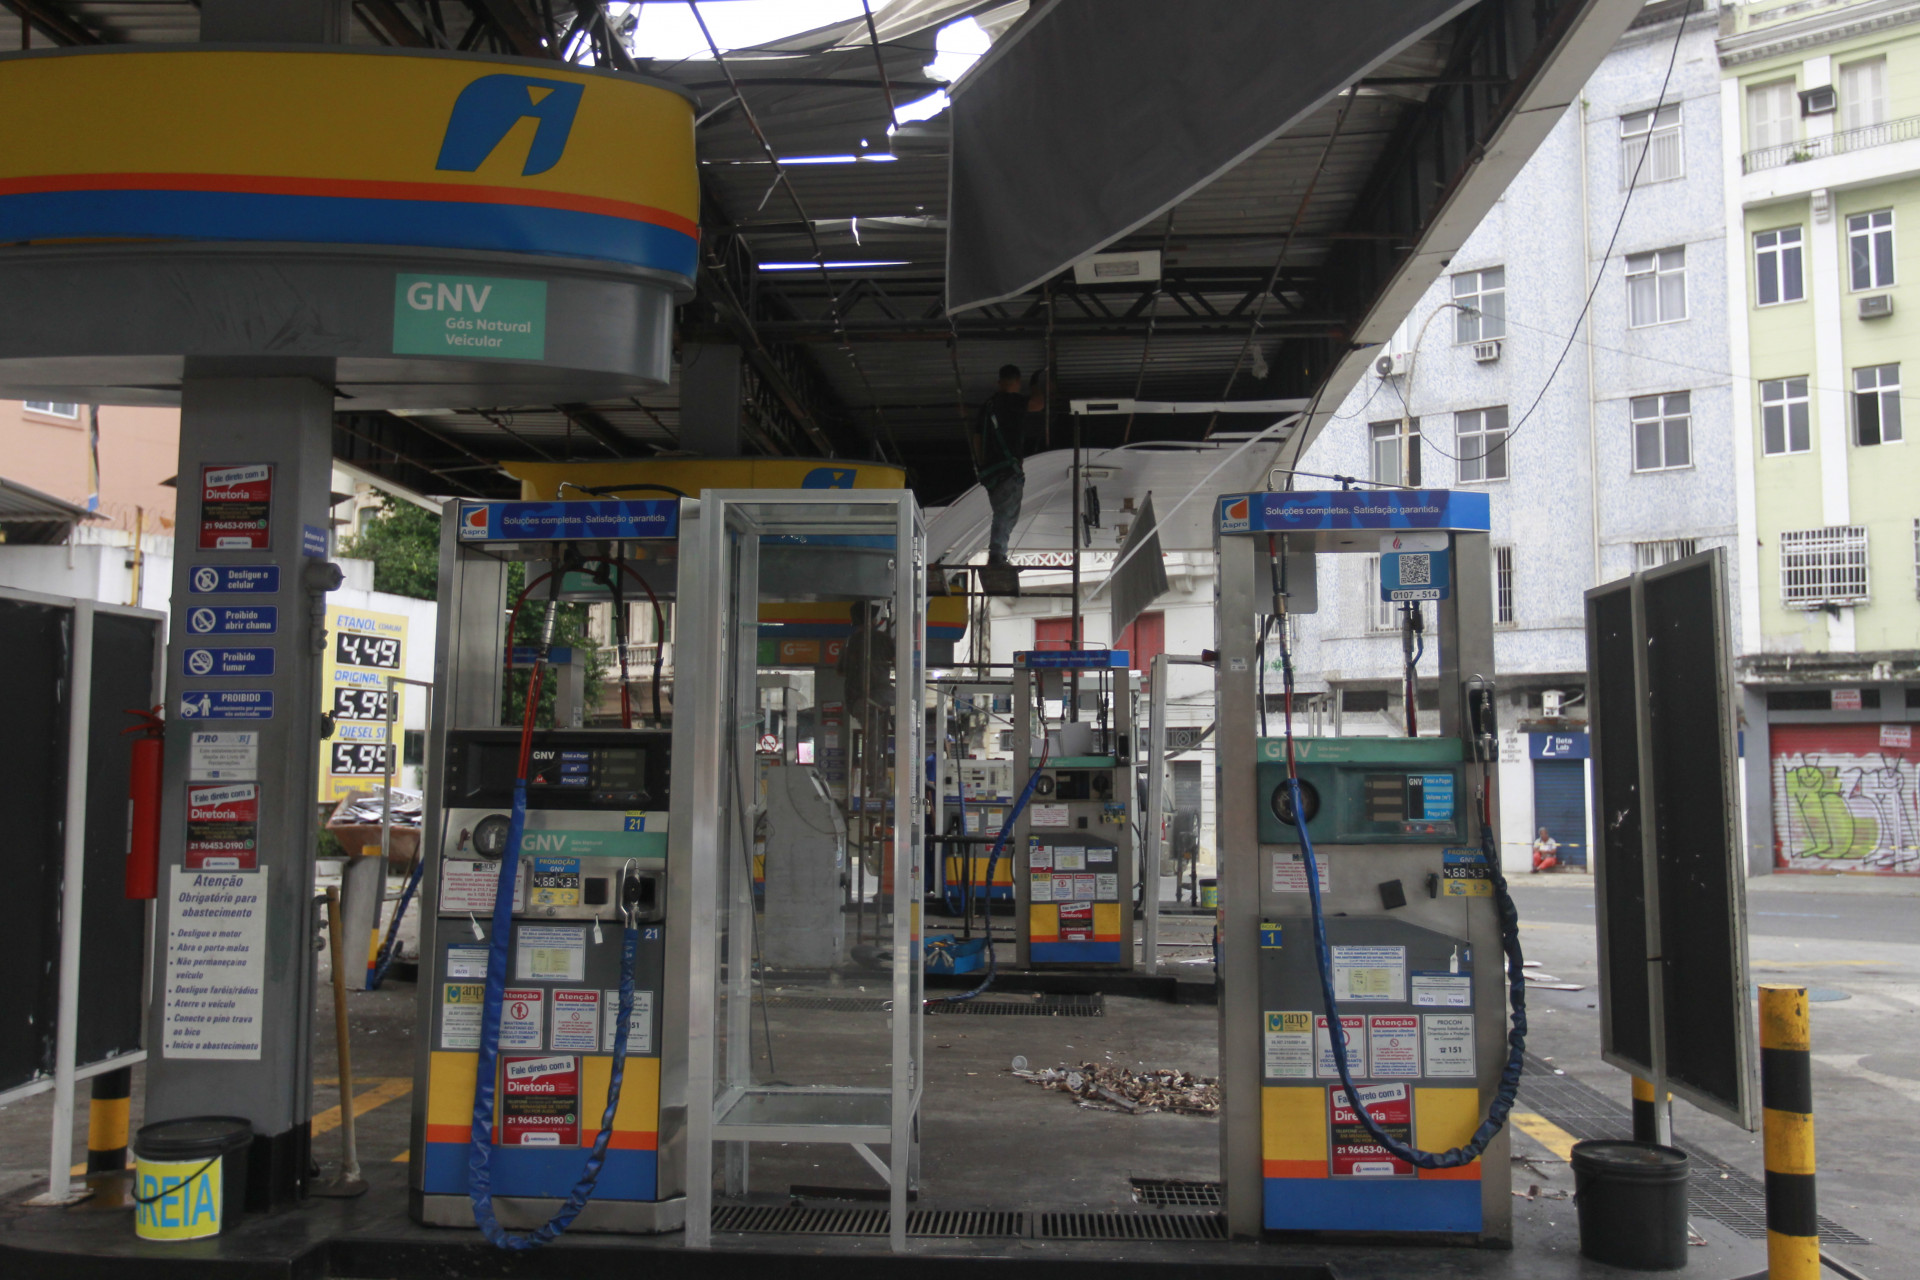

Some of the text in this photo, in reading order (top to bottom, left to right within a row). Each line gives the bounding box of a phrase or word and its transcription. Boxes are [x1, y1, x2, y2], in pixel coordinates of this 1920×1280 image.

[407, 281, 492, 313] GNV
[445, 317, 531, 333] Gás Natural
[445, 333, 503, 348] Veicular
[210, 475, 223, 483] Fale
[225, 473, 243, 481] direto
[245, 471, 259, 479] com
[206, 489, 250, 499] Diretoria
[1265, 505, 1441, 517] Soluções completas. Satisfação garantida.
[503, 514, 667, 526] Soluções completas. Satisfação garantida.
[1222, 522, 1248, 530] Aspro
[461, 528, 487, 536] Aspro
[228, 570, 261, 580] Desligue
[227, 581, 254, 589] celular
[1393, 591, 1414, 599] 0107
[1422, 590, 1437, 598] 514
[225, 611, 258, 619] Proibido
[225, 621, 272, 629] abrir chama
[337, 614, 377, 631] ETANOL
[223, 652, 256, 661] Proibido
[342, 636, 397, 666] 4,49
[223, 663, 246, 671] fumar
[334, 670, 383, 685] ORIGINAL
[222, 693, 261, 702] PROIBIDO
[339, 726, 373, 739] DIESEL
[532, 751, 555, 760] GNV
[1408, 778, 1423, 786] GNV
[194, 793, 209, 803] Fale
[210, 791, 230, 800] direto
[231, 790, 245, 798] com
[191, 809, 236, 819] Diretoria
[629, 818, 641, 830] 21
[200, 842, 243, 850] 96453-0190
[521, 834, 567, 851] GNV
[539, 858, 576, 867] PROMOÇÃO
[1444, 868, 1466, 878] 4,68
[193, 874, 244, 890] Atenção
[535, 876, 579, 888] 4,68 4,37
[178, 892, 257, 905] Obrigatório para
[181, 906, 252, 918] abastecimento
[177, 928, 211, 939] Desligue
[219, 930, 242, 938] motor
[645, 928, 658, 939] 21
[1268, 932, 1274, 945] 1
[177, 944, 196, 952] Abra
[203, 944, 249, 953] porta-malas
[1463, 949, 1470, 961] 1
[176, 957, 192, 966] Não
[192, 958, 236, 968] permaneça
[176, 971, 204, 979] veículo
[175, 985, 259, 996] Desligue faróis/rádios
[462, 985, 485, 999] anp
[503, 992, 538, 1000] Atenção
[558, 992, 595, 1001] Atenção
[174, 1000, 200, 1008] Aterre
[207, 1000, 236, 1008] veículo
[174, 1013, 205, 1023] Conecte
[212, 1014, 230, 1024] pino
[232, 1015, 253, 1023] trava
[1284, 1013, 1309, 1028] anp
[1374, 1019, 1414, 1027] Atenção
[184, 1027, 201, 1036] bico
[172, 1041, 194, 1049] Inicie
[202, 1042, 259, 1050] abastecimento
[511, 1066, 526, 1075] Fale
[528, 1064, 548, 1073] direto
[549, 1062, 565, 1070] com
[508, 1081, 555, 1092] Diretoria
[1360, 1092, 1377, 1101] ireto
[1378, 1091, 1395, 1099] com
[518, 1116, 564, 1124] 96453-0190
[1335, 1110, 1386, 1121] Direria
[1347, 1146, 1391, 1154] 96453-01
